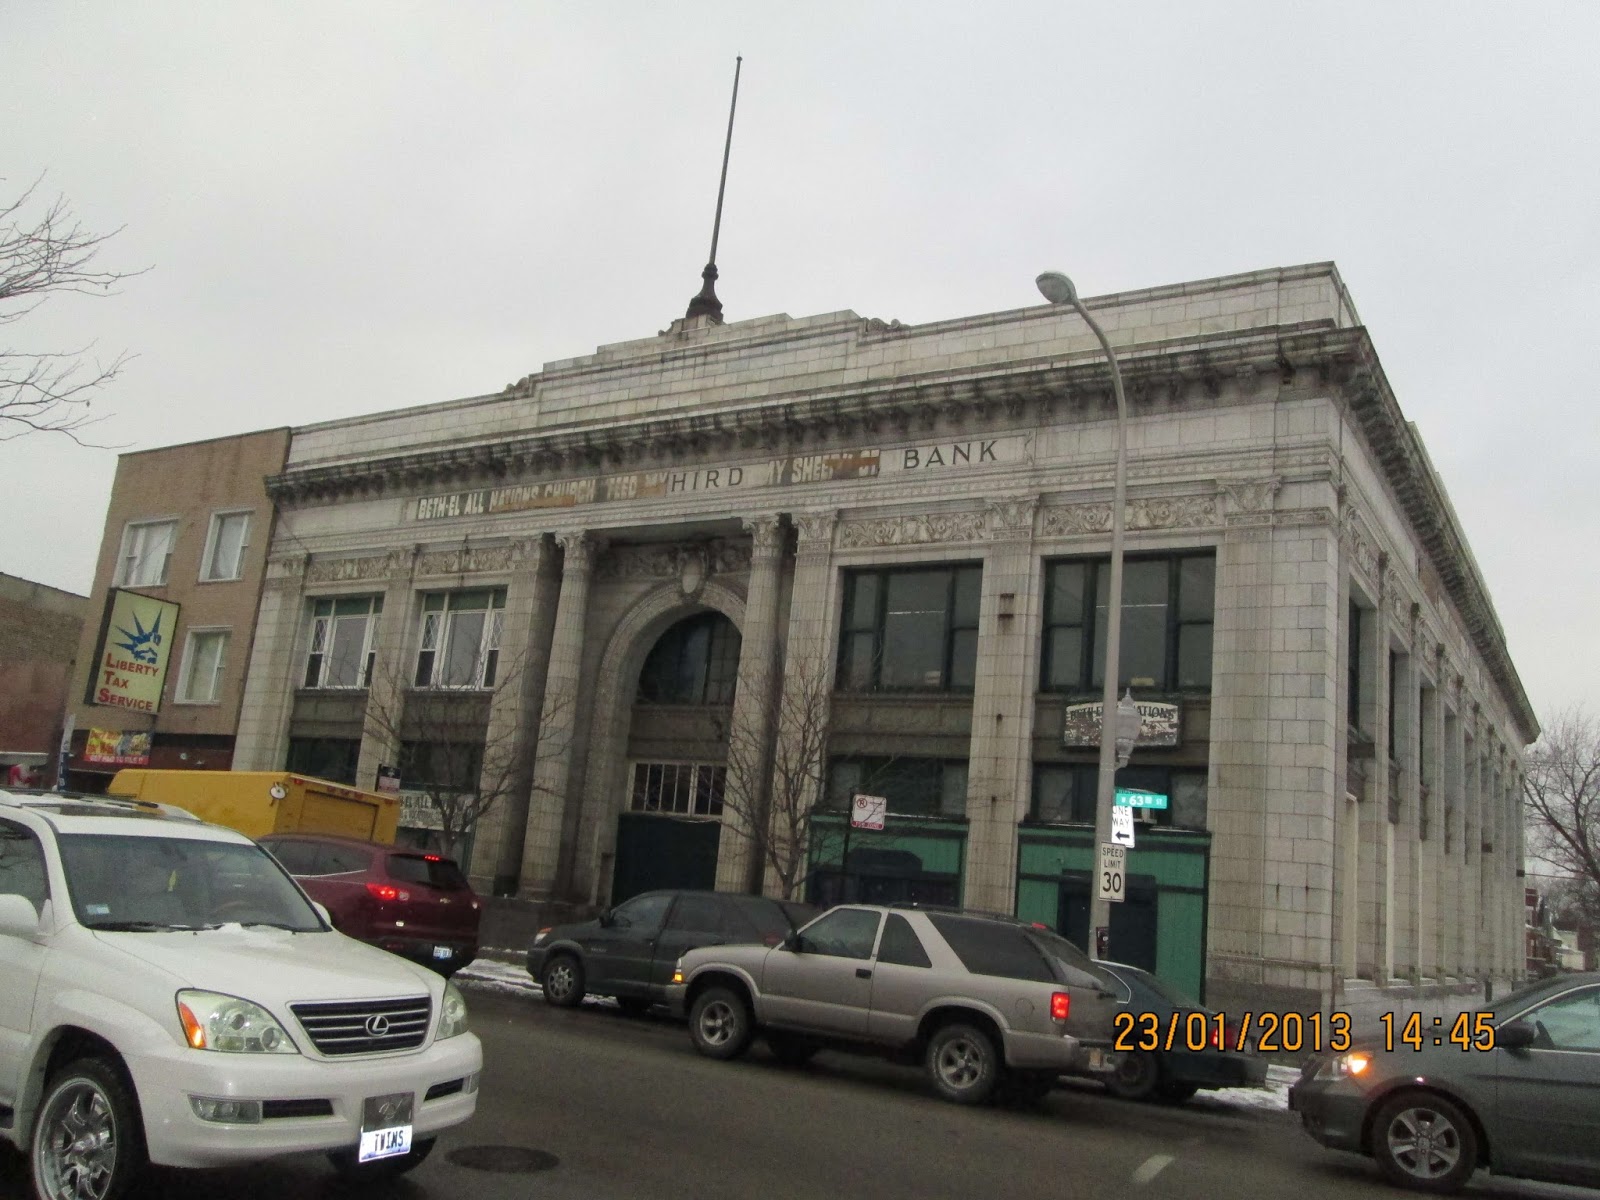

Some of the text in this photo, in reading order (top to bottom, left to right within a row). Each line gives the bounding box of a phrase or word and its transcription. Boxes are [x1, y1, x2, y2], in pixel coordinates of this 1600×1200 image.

[903, 440, 999, 470] BANK
[418, 495, 460, 519] BETH-EL
[464, 493, 484, 514] ALL
[105, 653, 160, 677] LIBERTY
[104, 671, 129, 689] TAX
[98, 688, 153, 711] SERVICE
[1137, 705, 1175, 720] ATIONS
[1112, 805, 1129, 816] ONE
[1112, 817, 1129, 827] WAY
[1102, 847, 1124, 858] SPEED
[1103, 859, 1121, 869] LIMIT
[1102, 871, 1122, 893] 30
